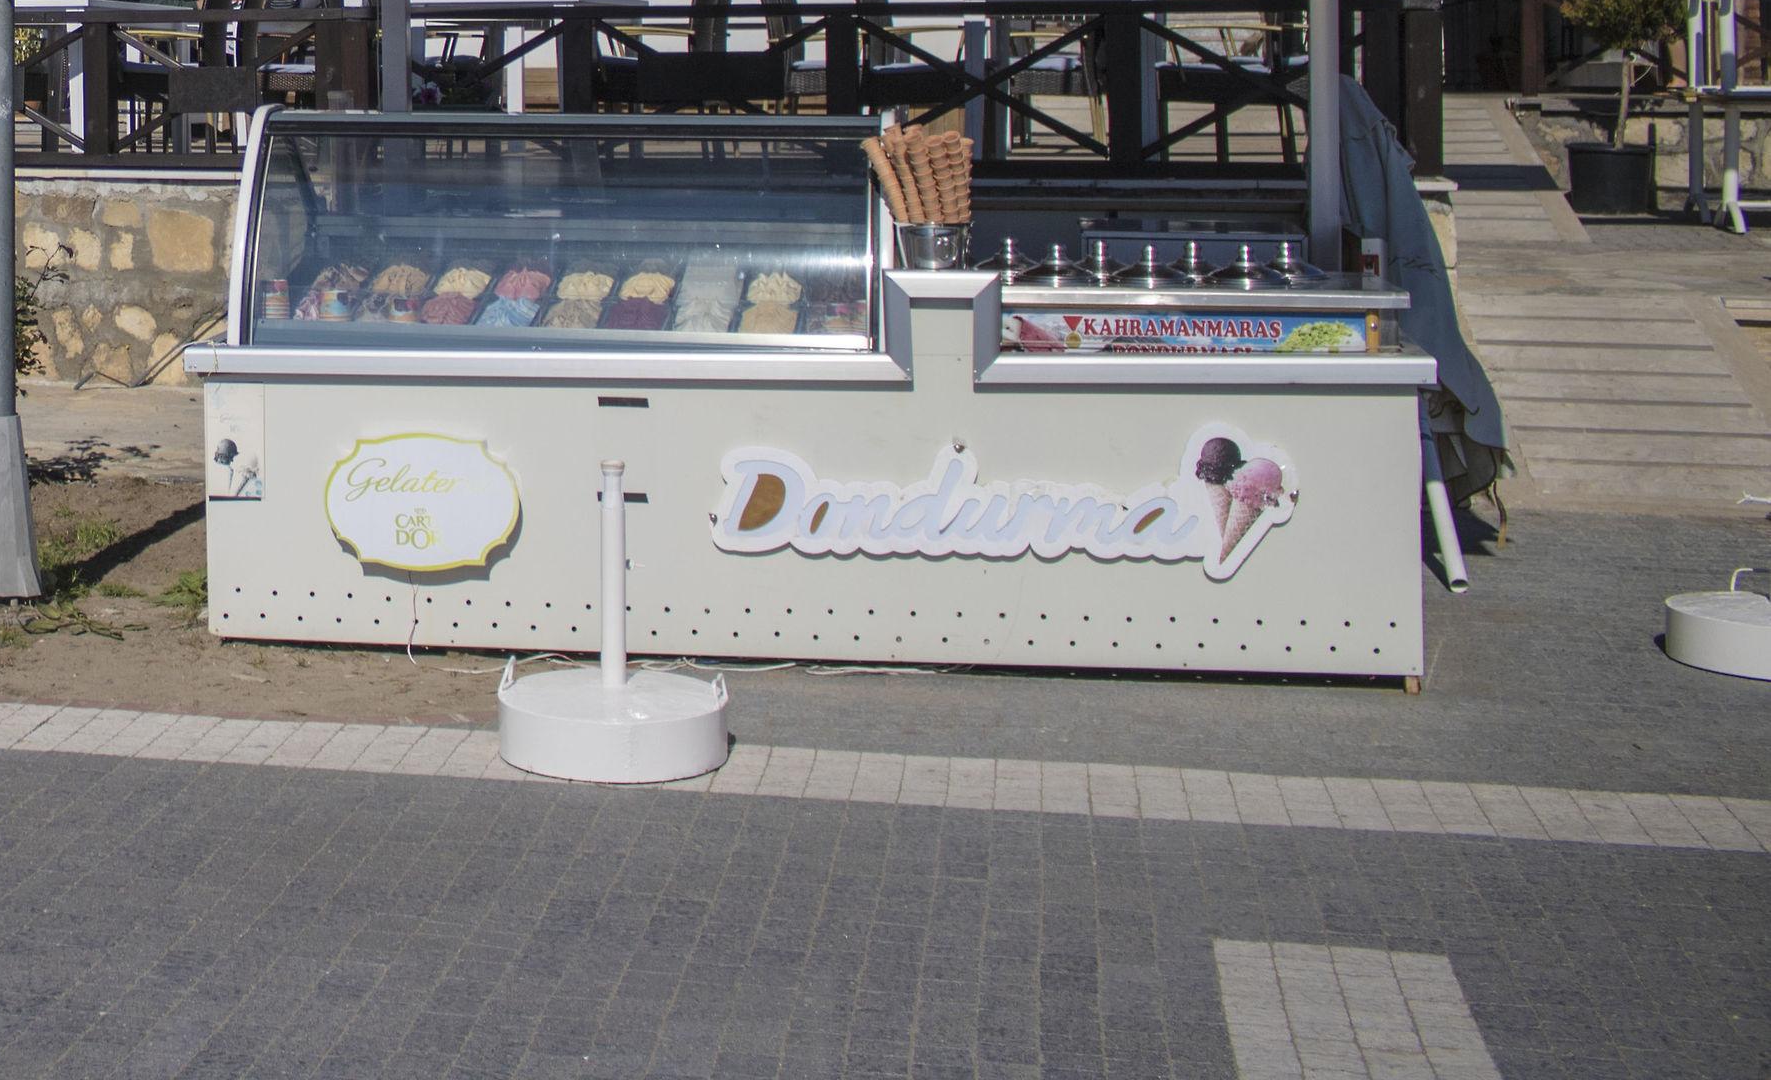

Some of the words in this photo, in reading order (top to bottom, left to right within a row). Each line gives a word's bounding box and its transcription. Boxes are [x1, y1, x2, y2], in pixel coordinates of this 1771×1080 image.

[1083, 318, 1282, 343] KAHRAMANMARAŞ
[345, 457, 484, 502] Gelater
[729, 457, 1200, 545] Dondurma
